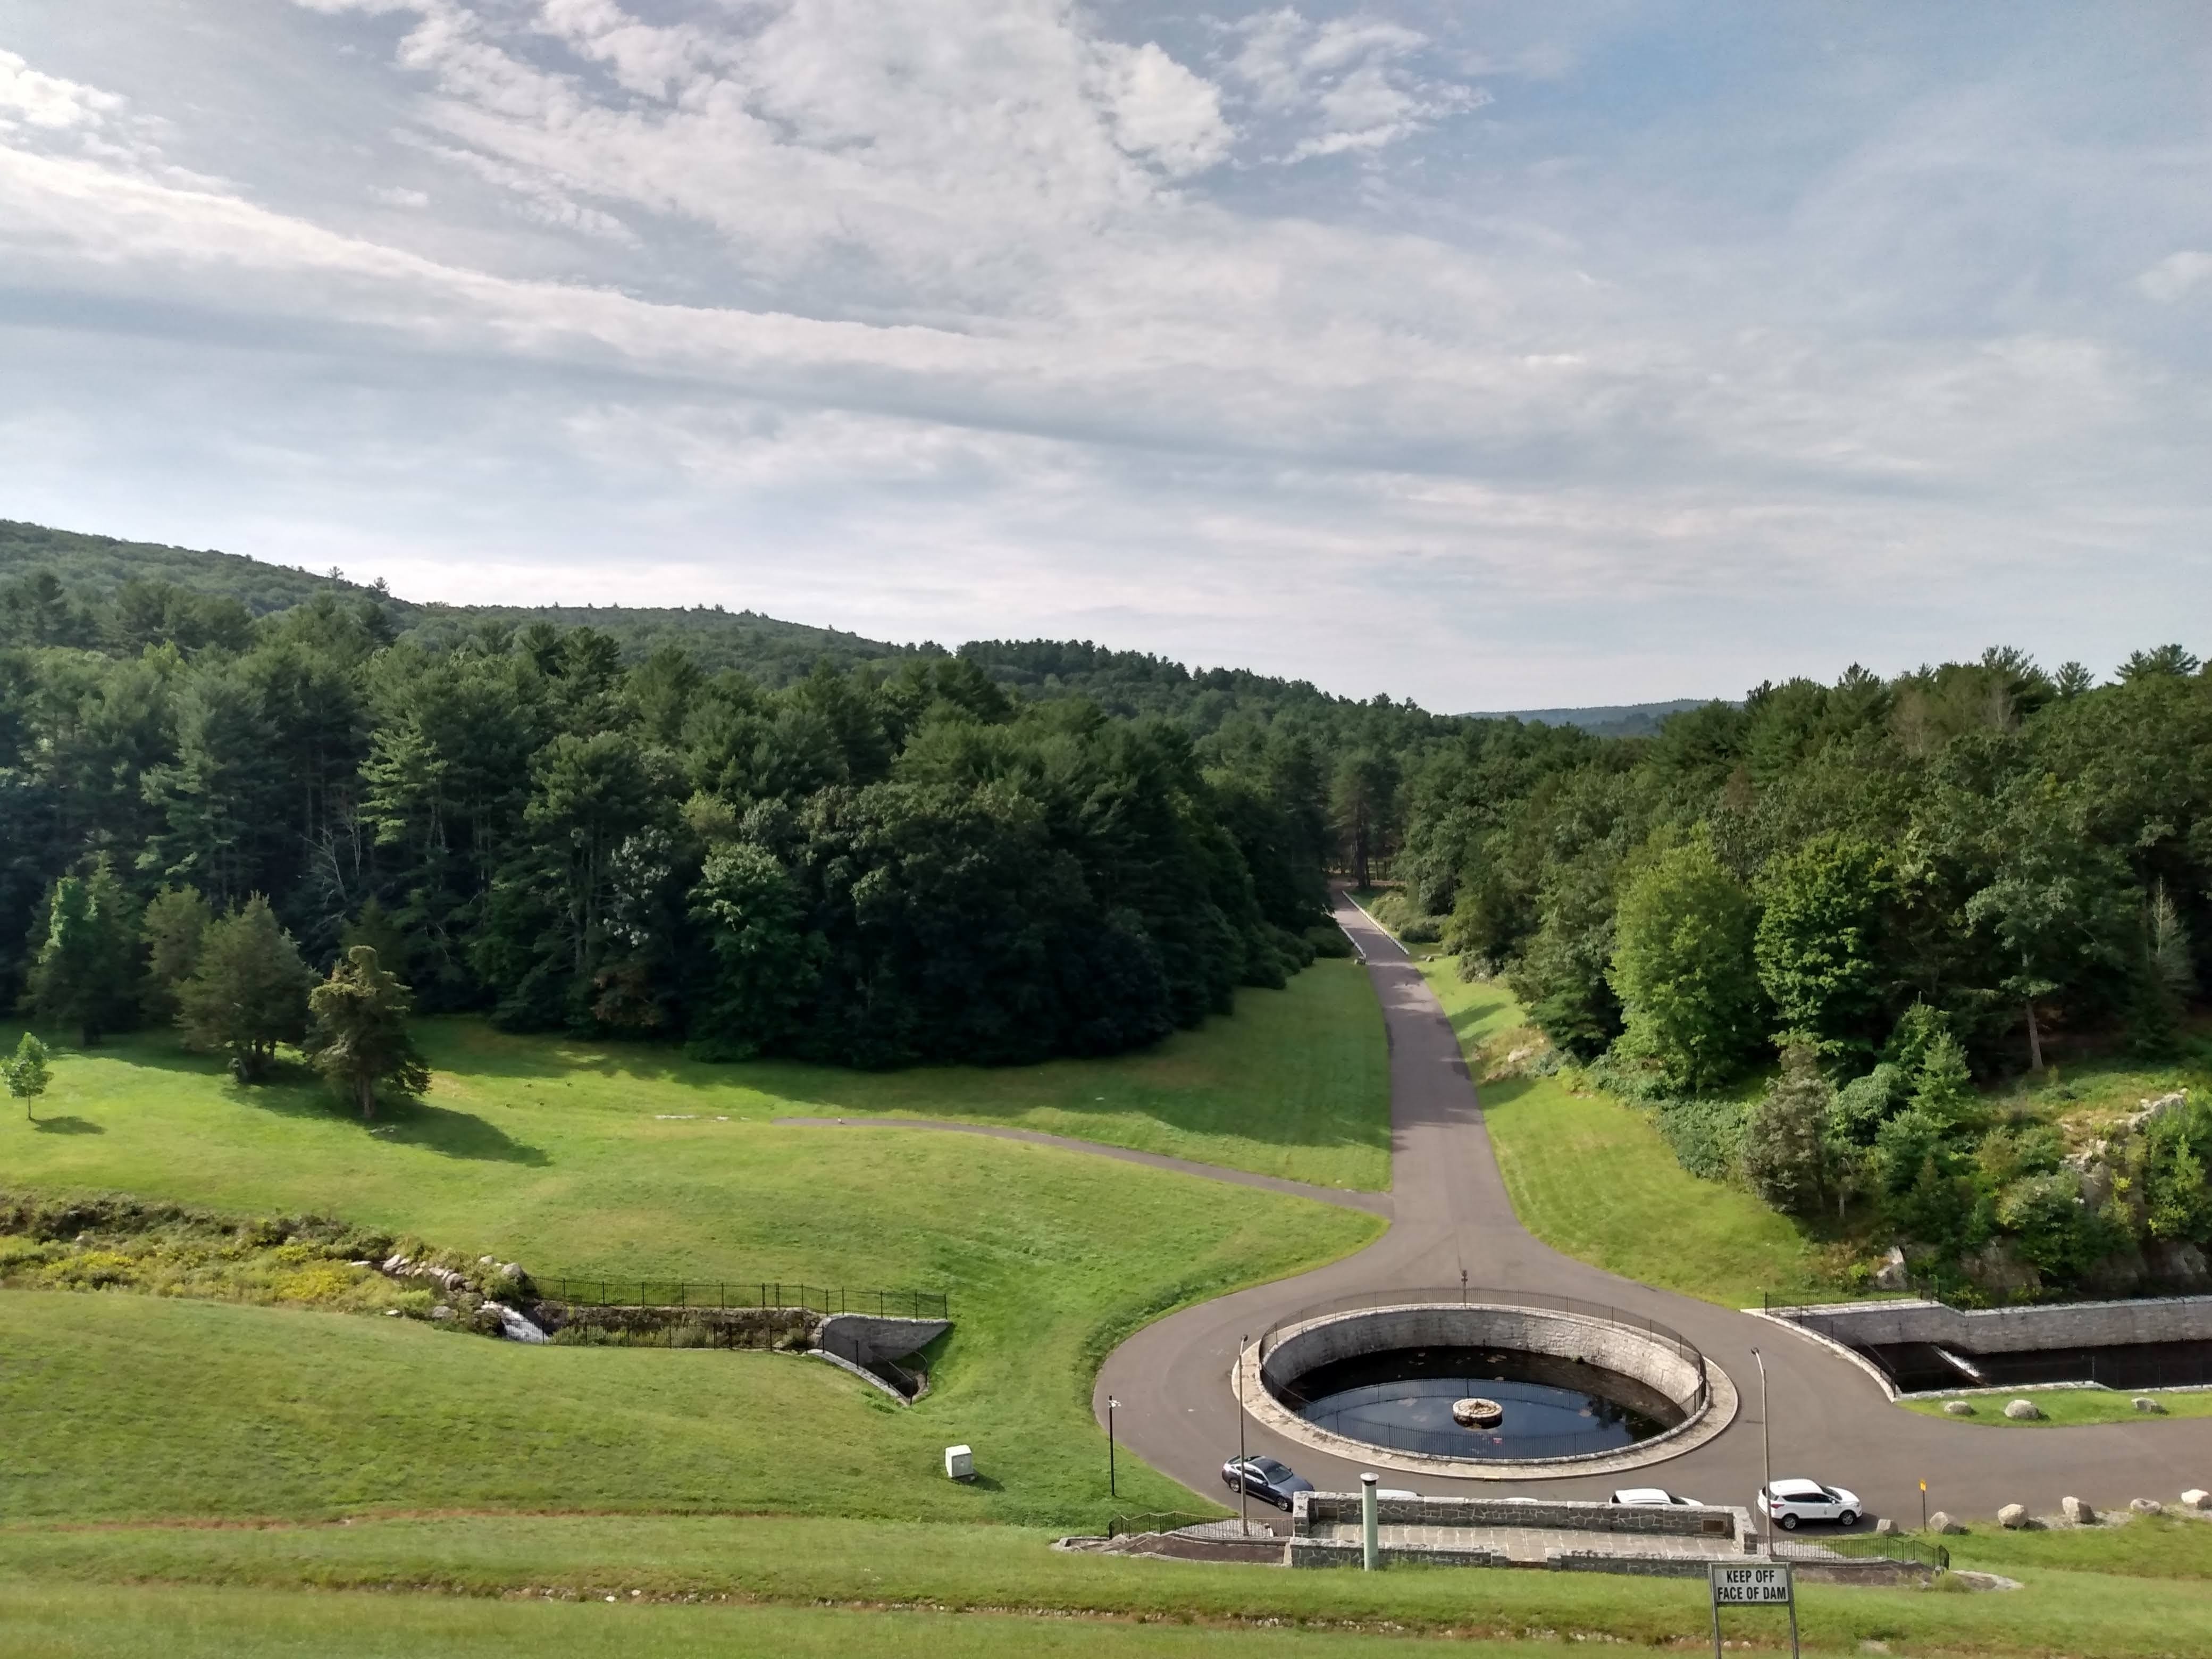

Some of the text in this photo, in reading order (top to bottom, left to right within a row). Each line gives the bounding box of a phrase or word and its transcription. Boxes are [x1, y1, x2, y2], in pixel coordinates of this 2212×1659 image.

[1727, 1570, 1774, 1583] KEEP OFF
[1717, 1587, 1786, 1600] FACE OF DAM
